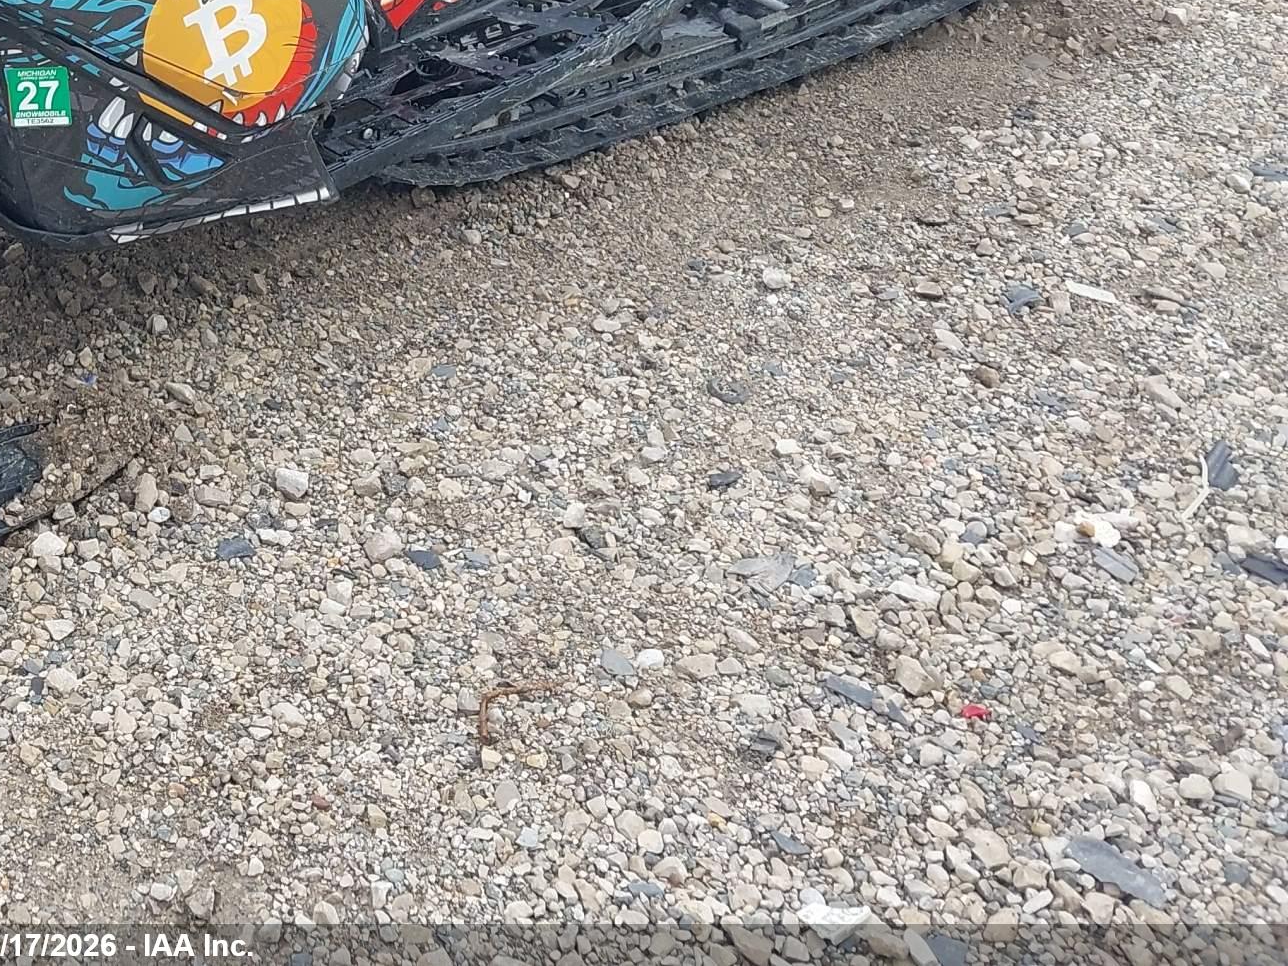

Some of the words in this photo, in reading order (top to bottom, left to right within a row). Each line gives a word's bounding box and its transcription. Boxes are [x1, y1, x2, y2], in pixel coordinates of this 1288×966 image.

[17, 69, 57, 78] MICHIGAN
[16, 80, 60, 111] 27
[15, 110, 66, 119] SNOWMOBILE
